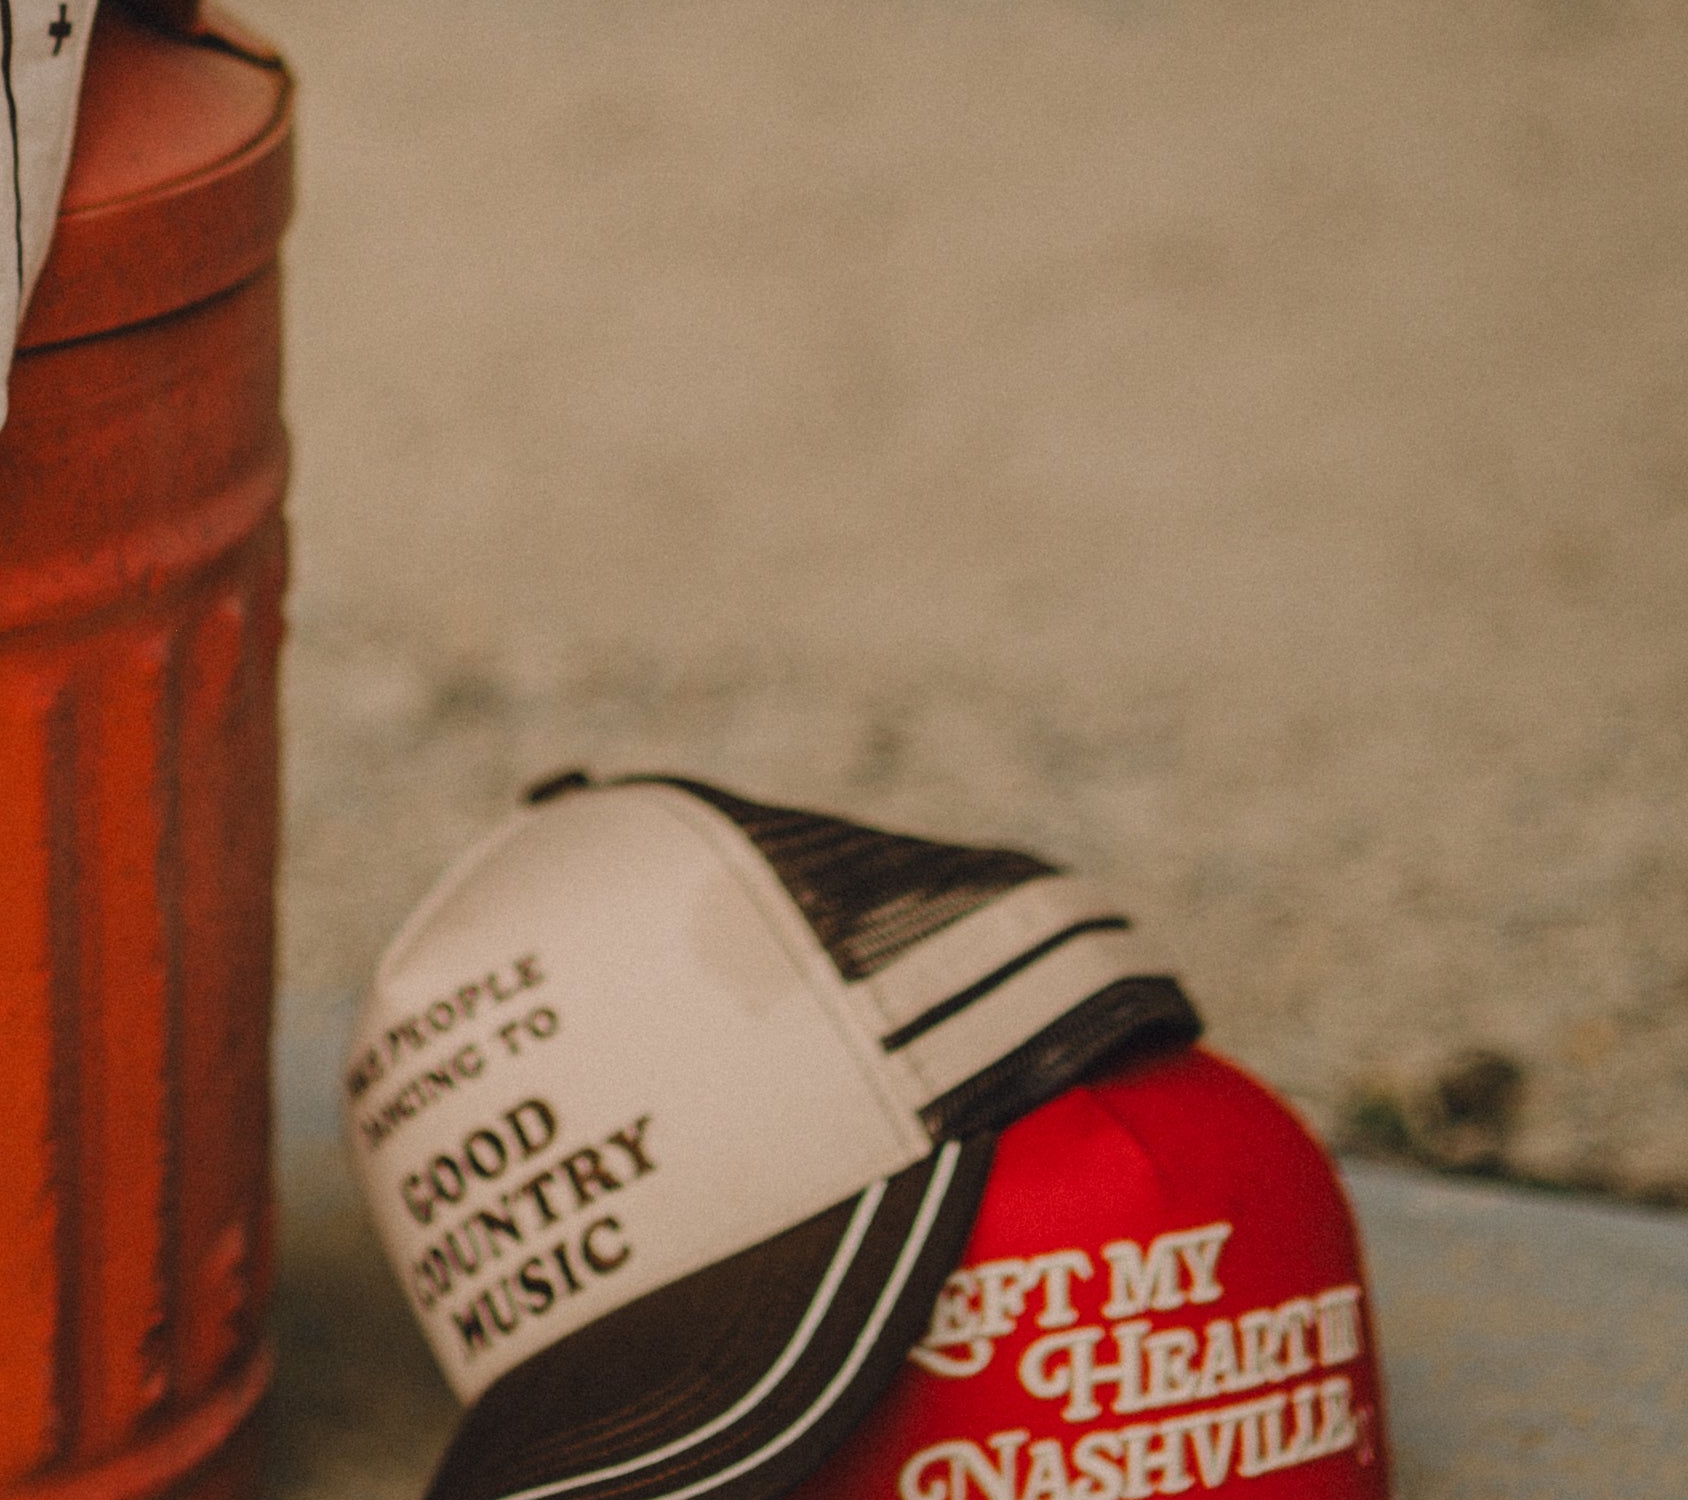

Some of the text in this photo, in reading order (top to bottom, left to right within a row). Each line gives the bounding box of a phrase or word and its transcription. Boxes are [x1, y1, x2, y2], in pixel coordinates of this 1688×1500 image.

[498, 1005, 560, 1055] TO
[401, 1097, 560, 1226] GOOD
[451, 1214, 633, 1358] MUSIC
[907, 1220, 1234, 1379] EFT MY
[1017, 1294, 1316, 1423] HEART
